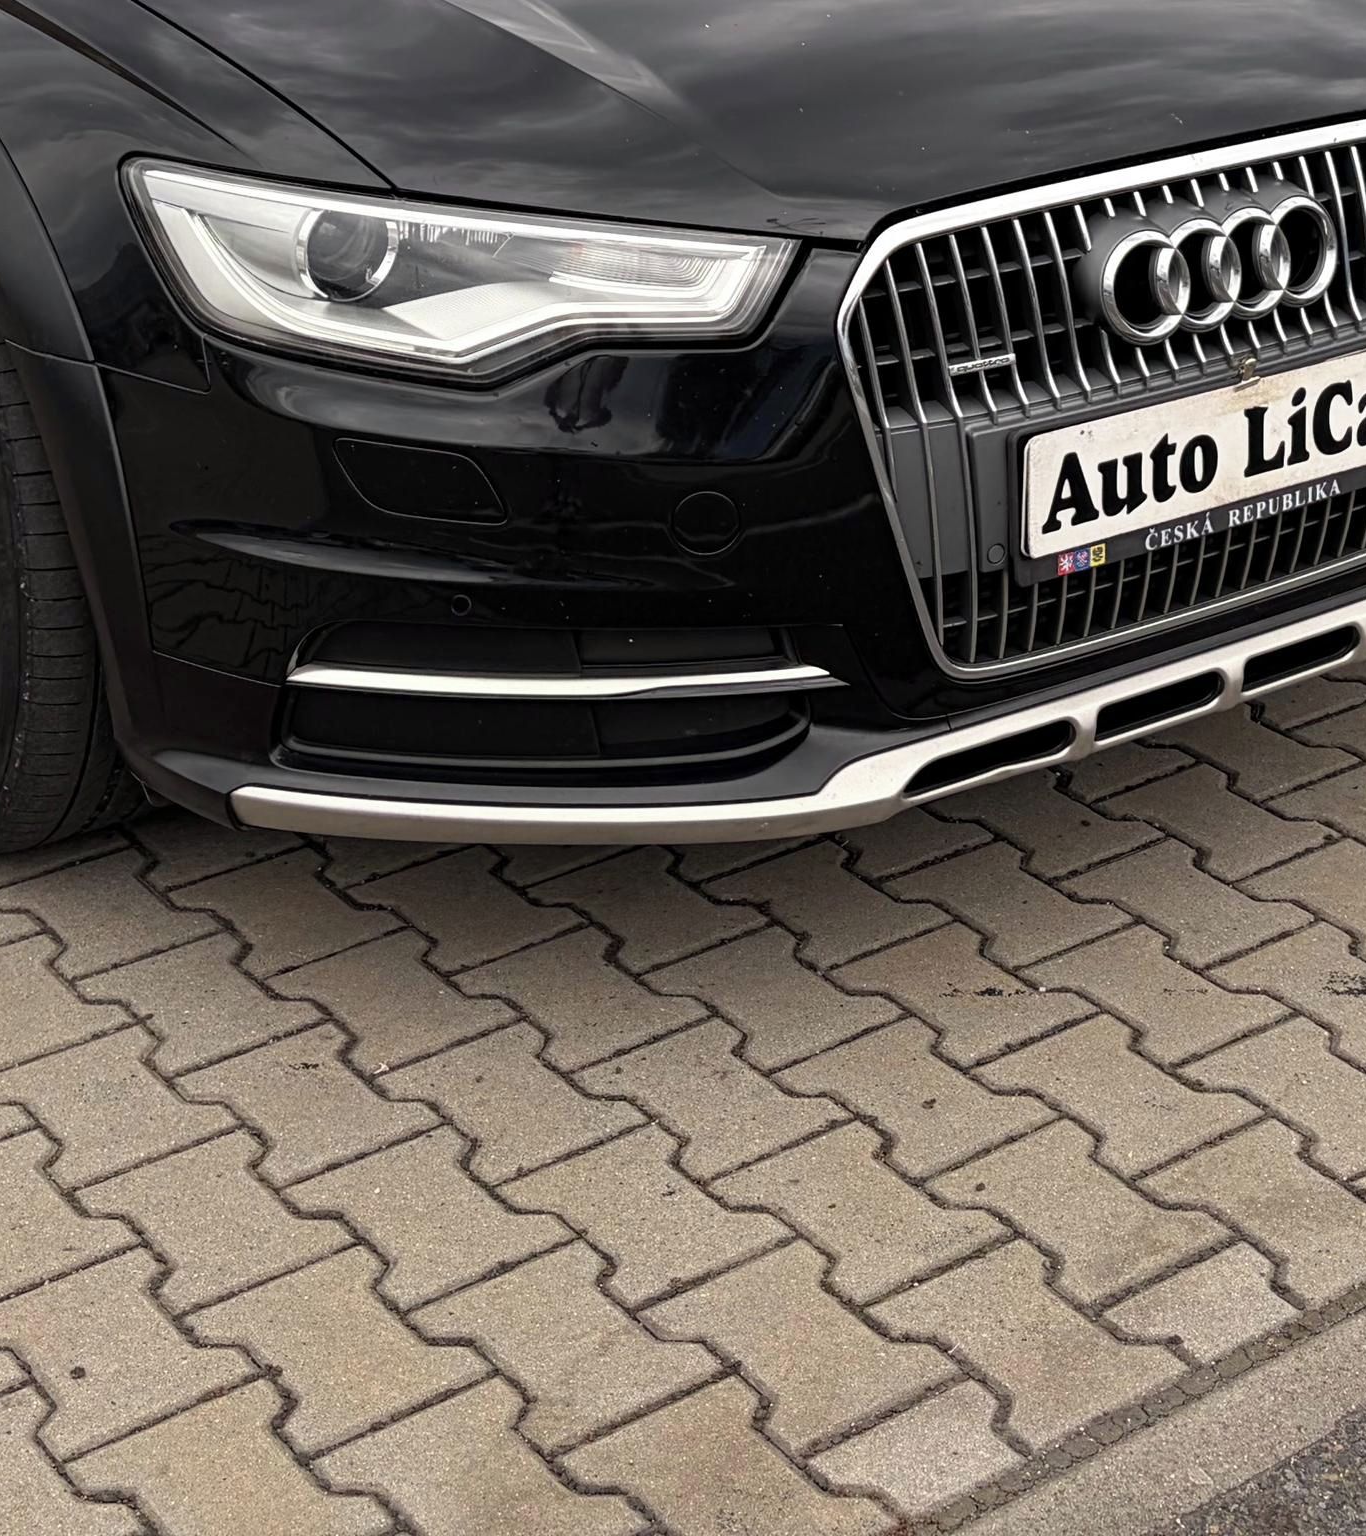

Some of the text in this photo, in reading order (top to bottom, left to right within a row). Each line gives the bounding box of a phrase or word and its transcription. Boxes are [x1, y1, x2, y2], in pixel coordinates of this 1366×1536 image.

[956, 356, 1011, 373] quattro
[1042, 433, 1219, 534] Auto
[1144, 478, 1342, 552] ČESKÁ REPUBLIKA
